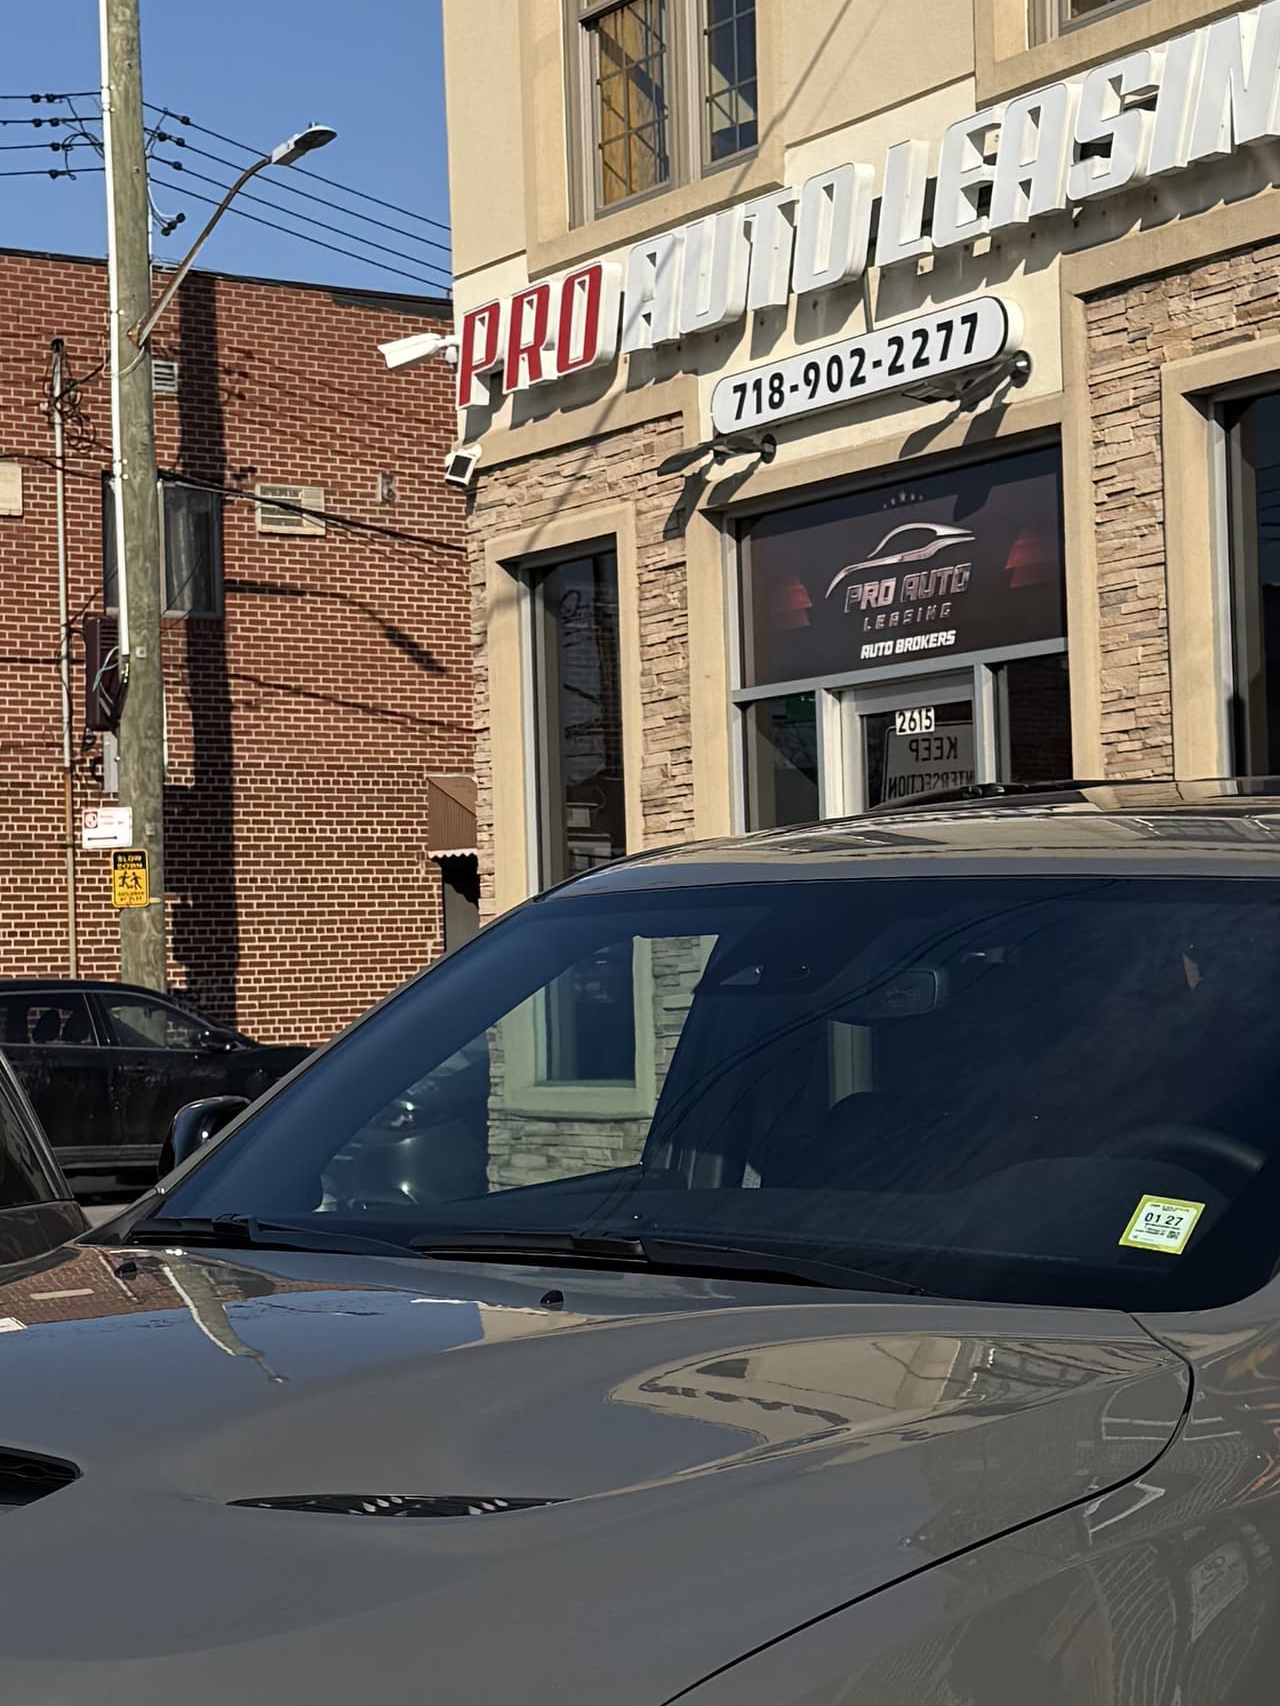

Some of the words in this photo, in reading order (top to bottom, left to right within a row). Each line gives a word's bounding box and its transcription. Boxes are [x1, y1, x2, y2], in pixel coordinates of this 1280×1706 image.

[456, 260, 623, 410] PRO
[621, 161, 876, 353] AUTO
[731, 310, 980, 423] 718-902-2277
[844, 577, 897, 614] PRO
[900, 562, 972, 603] AUTO
[863, 601, 953, 633] LEASING
[860, 640, 894, 660] AUTO
[895, 629, 957, 654] BROKERS
[897, 708, 934, 733] 2615
[1145, 1212, 1162, 1223] 01
[1166, 1215, 1184, 1226] 27
